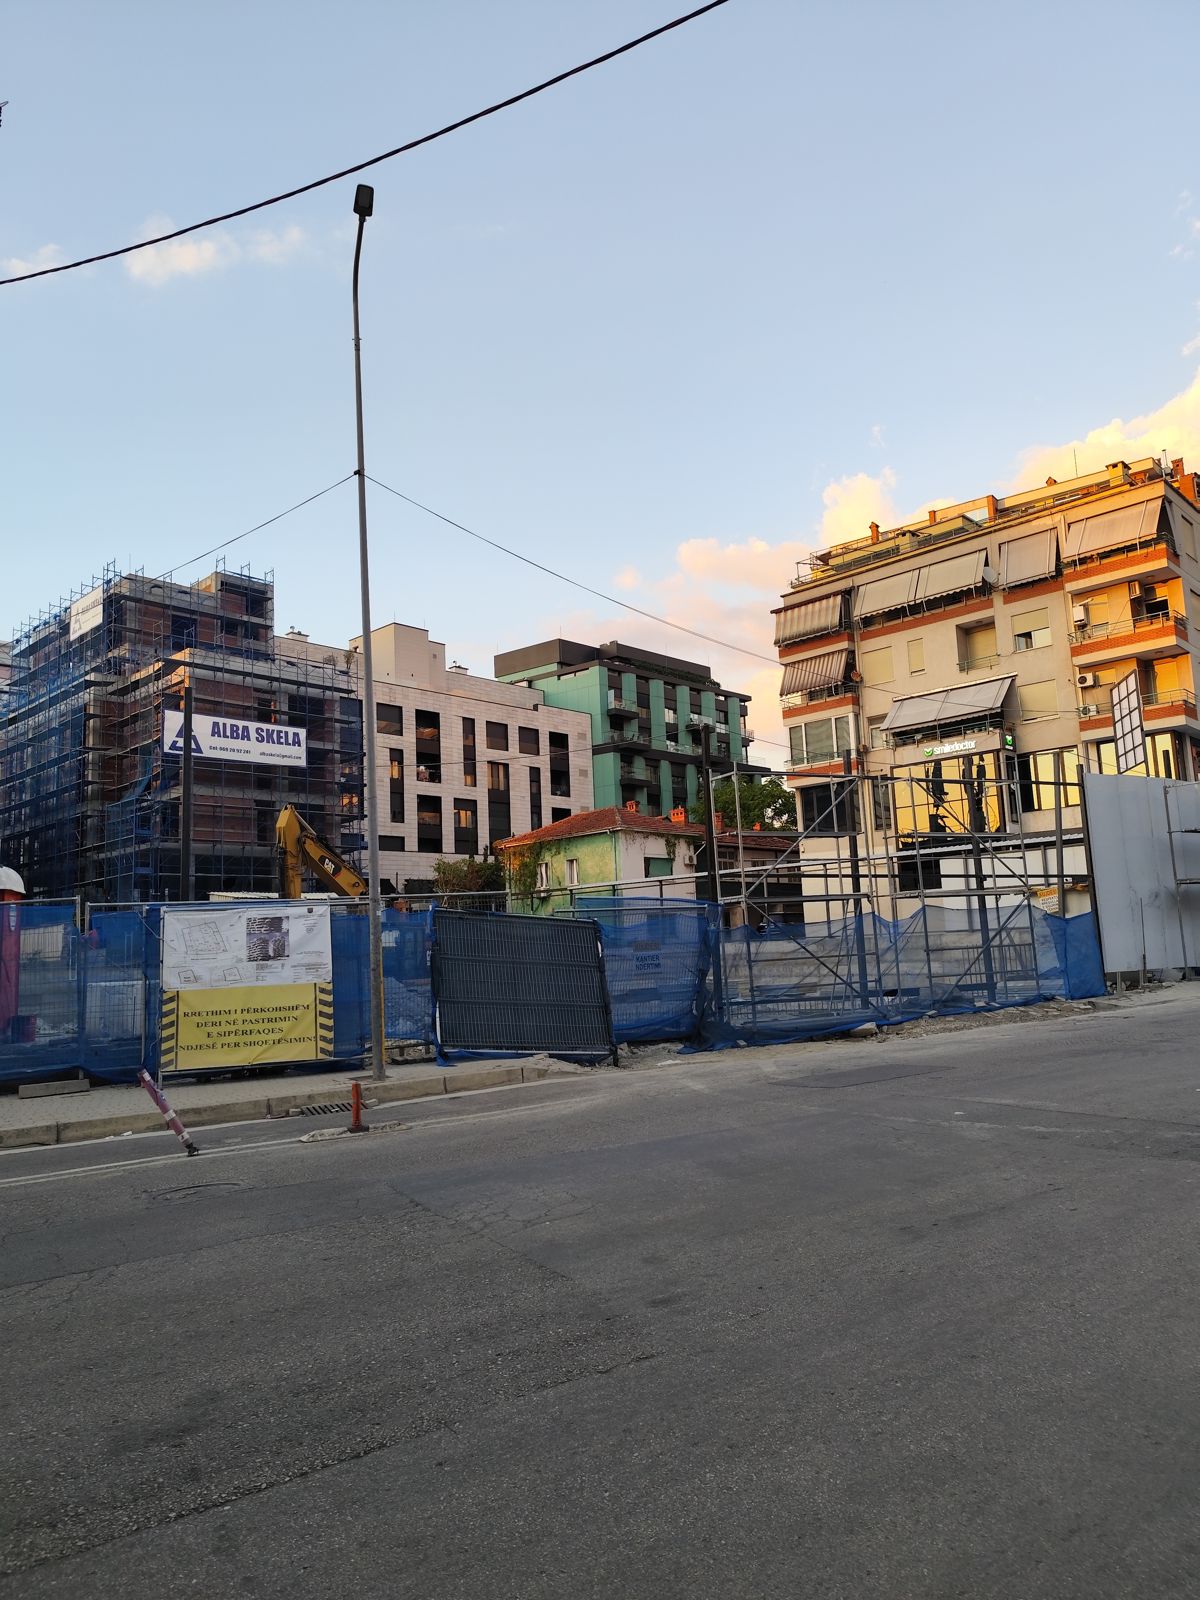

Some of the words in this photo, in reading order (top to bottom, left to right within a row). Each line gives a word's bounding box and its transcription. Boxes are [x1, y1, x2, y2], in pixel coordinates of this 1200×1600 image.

[211, 721, 251, 741] ALBA
[255, 727, 302, 747] SKELA
[933, 740, 977, 754] smiledoctor
[325, 858, 335, 874] CAT
[183, 1008, 231, 1018] RRETHIM
[240, 1003, 310, 1014] PËRKOHSHËM
[196, 1020, 222, 1028] DERI
[241, 1015, 299, 1026] PASTRIMIN
[216, 1026, 284, 1038] SIPËRFAQES
